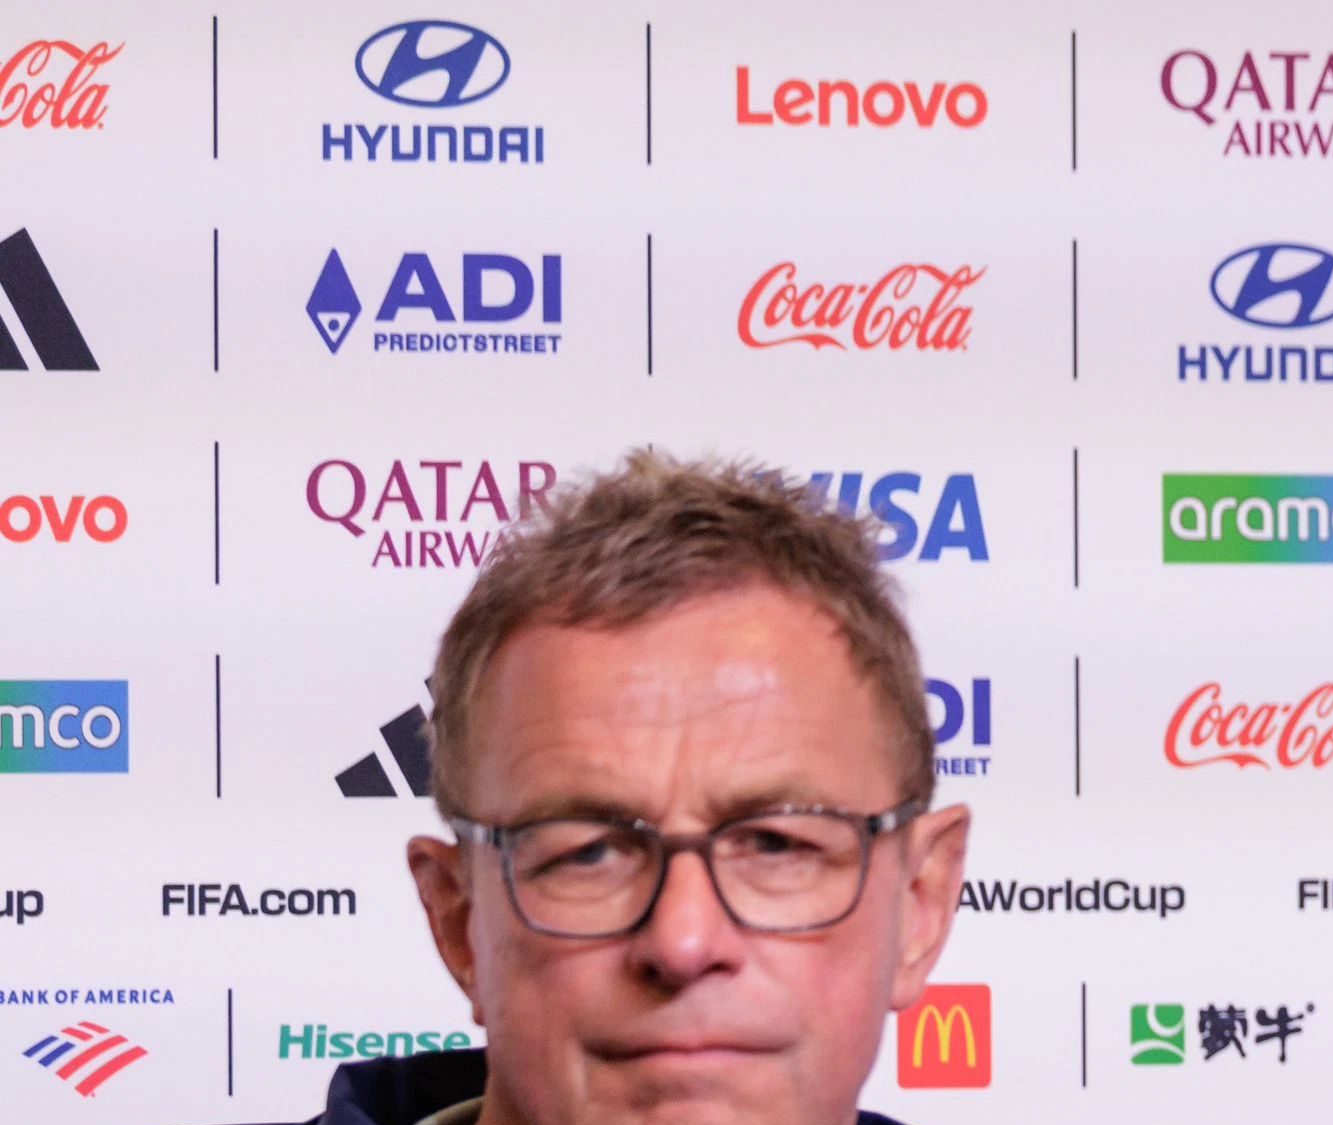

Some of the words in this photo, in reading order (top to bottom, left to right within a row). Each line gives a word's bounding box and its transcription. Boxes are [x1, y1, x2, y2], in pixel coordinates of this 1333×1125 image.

[736, 66, 988, 128] Lenovo
[323, 123, 544, 163] HYUNDAI
[375, 253, 562, 323] ADI
[737, 262, 985, 351] Coca-Cola
[374, 333, 561, 353] PREDICTSTREET
[304, 456, 560, 538] QATAR
[162, 884, 356, 916] FIFA.com
[55, 990, 79, 1004] OF
[85, 989, 174, 1004] AMERICA
[276, 1022, 474, 1060] Hisense
[1199, 1003, 1304, 1062] 蒙牛
